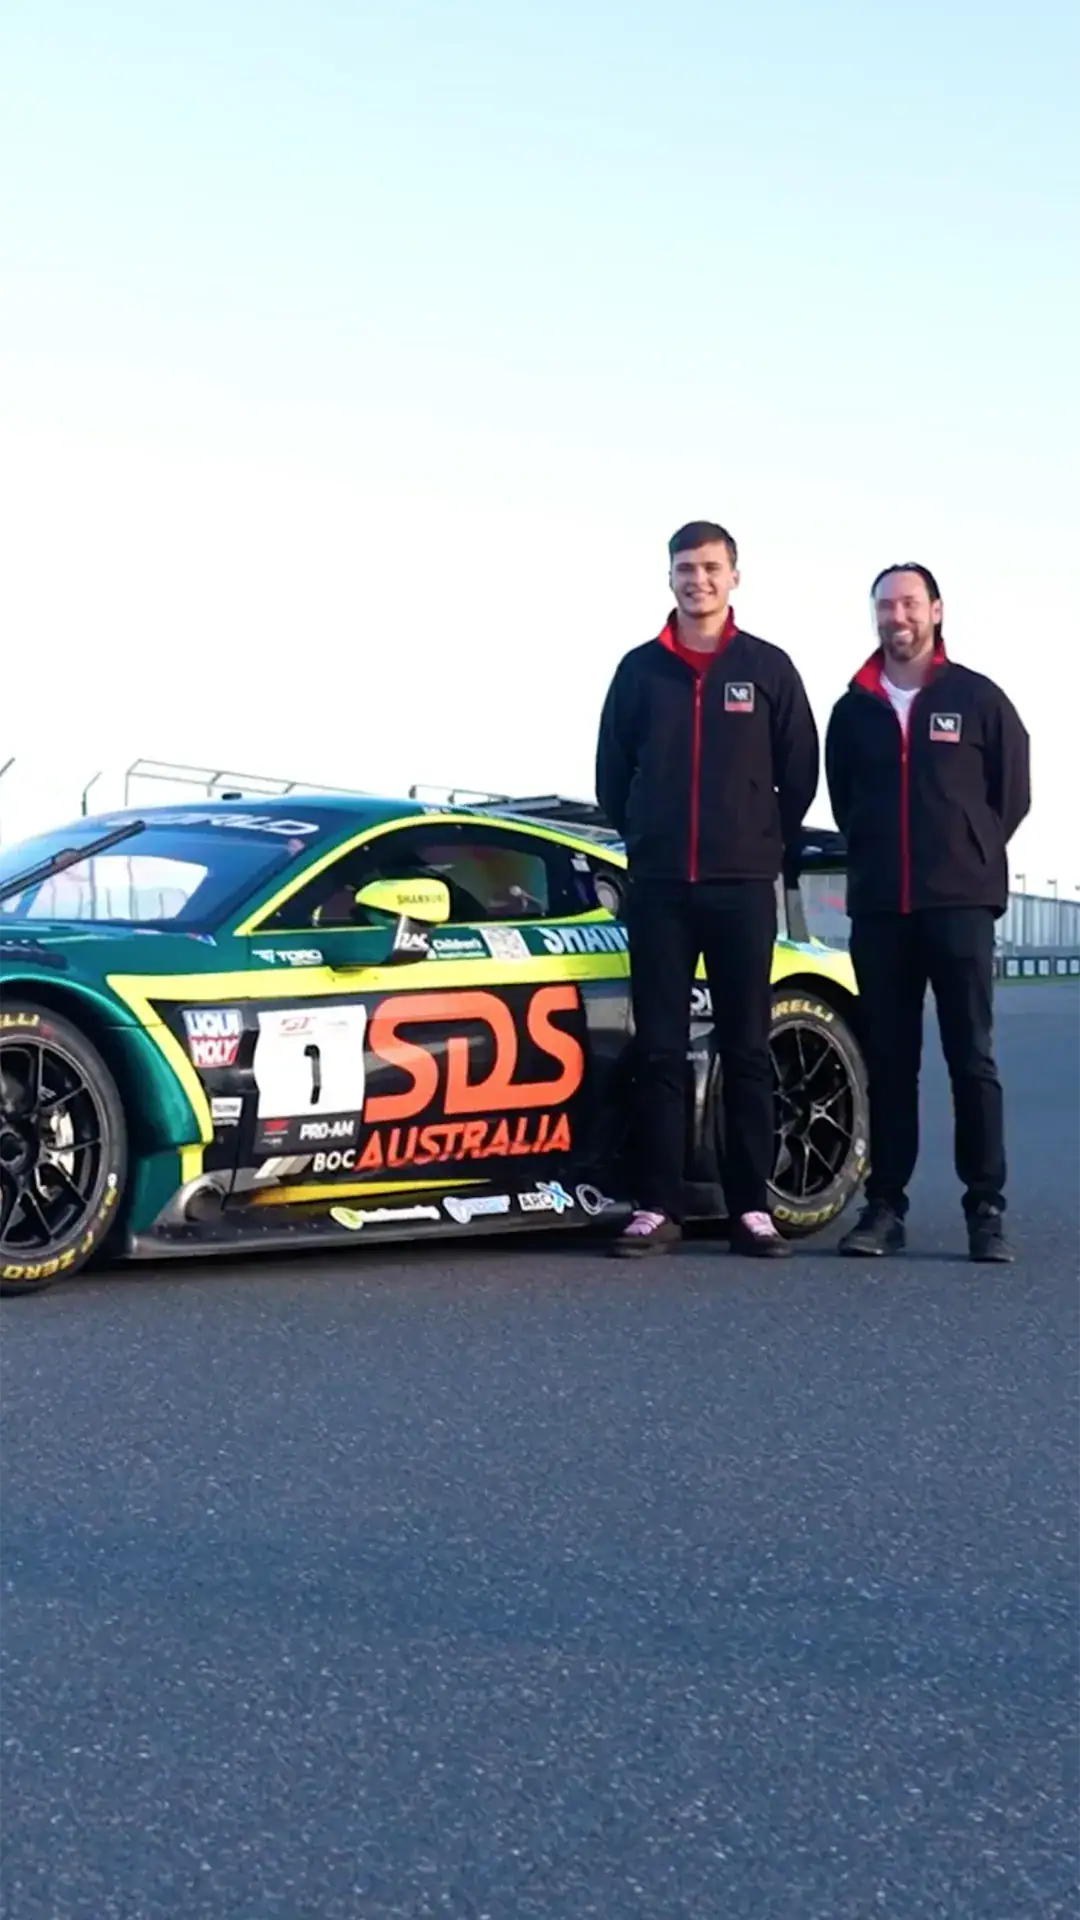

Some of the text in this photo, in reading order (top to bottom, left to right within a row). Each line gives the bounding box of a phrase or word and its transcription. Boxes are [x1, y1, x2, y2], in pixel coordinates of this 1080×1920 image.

[0, 1012, 40, 1028] LLI
[184, 1010, 241, 1036] LIQUI
[771, 999, 835, 1022] IRELLI
[190, 1038, 239, 1065] MOLY
[364, 985, 584, 1123] SDS
[304, 1044, 321, 1105] 1
[300, 1120, 355, 1141] PRO-AM
[353, 1113, 571, 1172] AUSTRALIA
[313, 1149, 356, 1173] BOC
